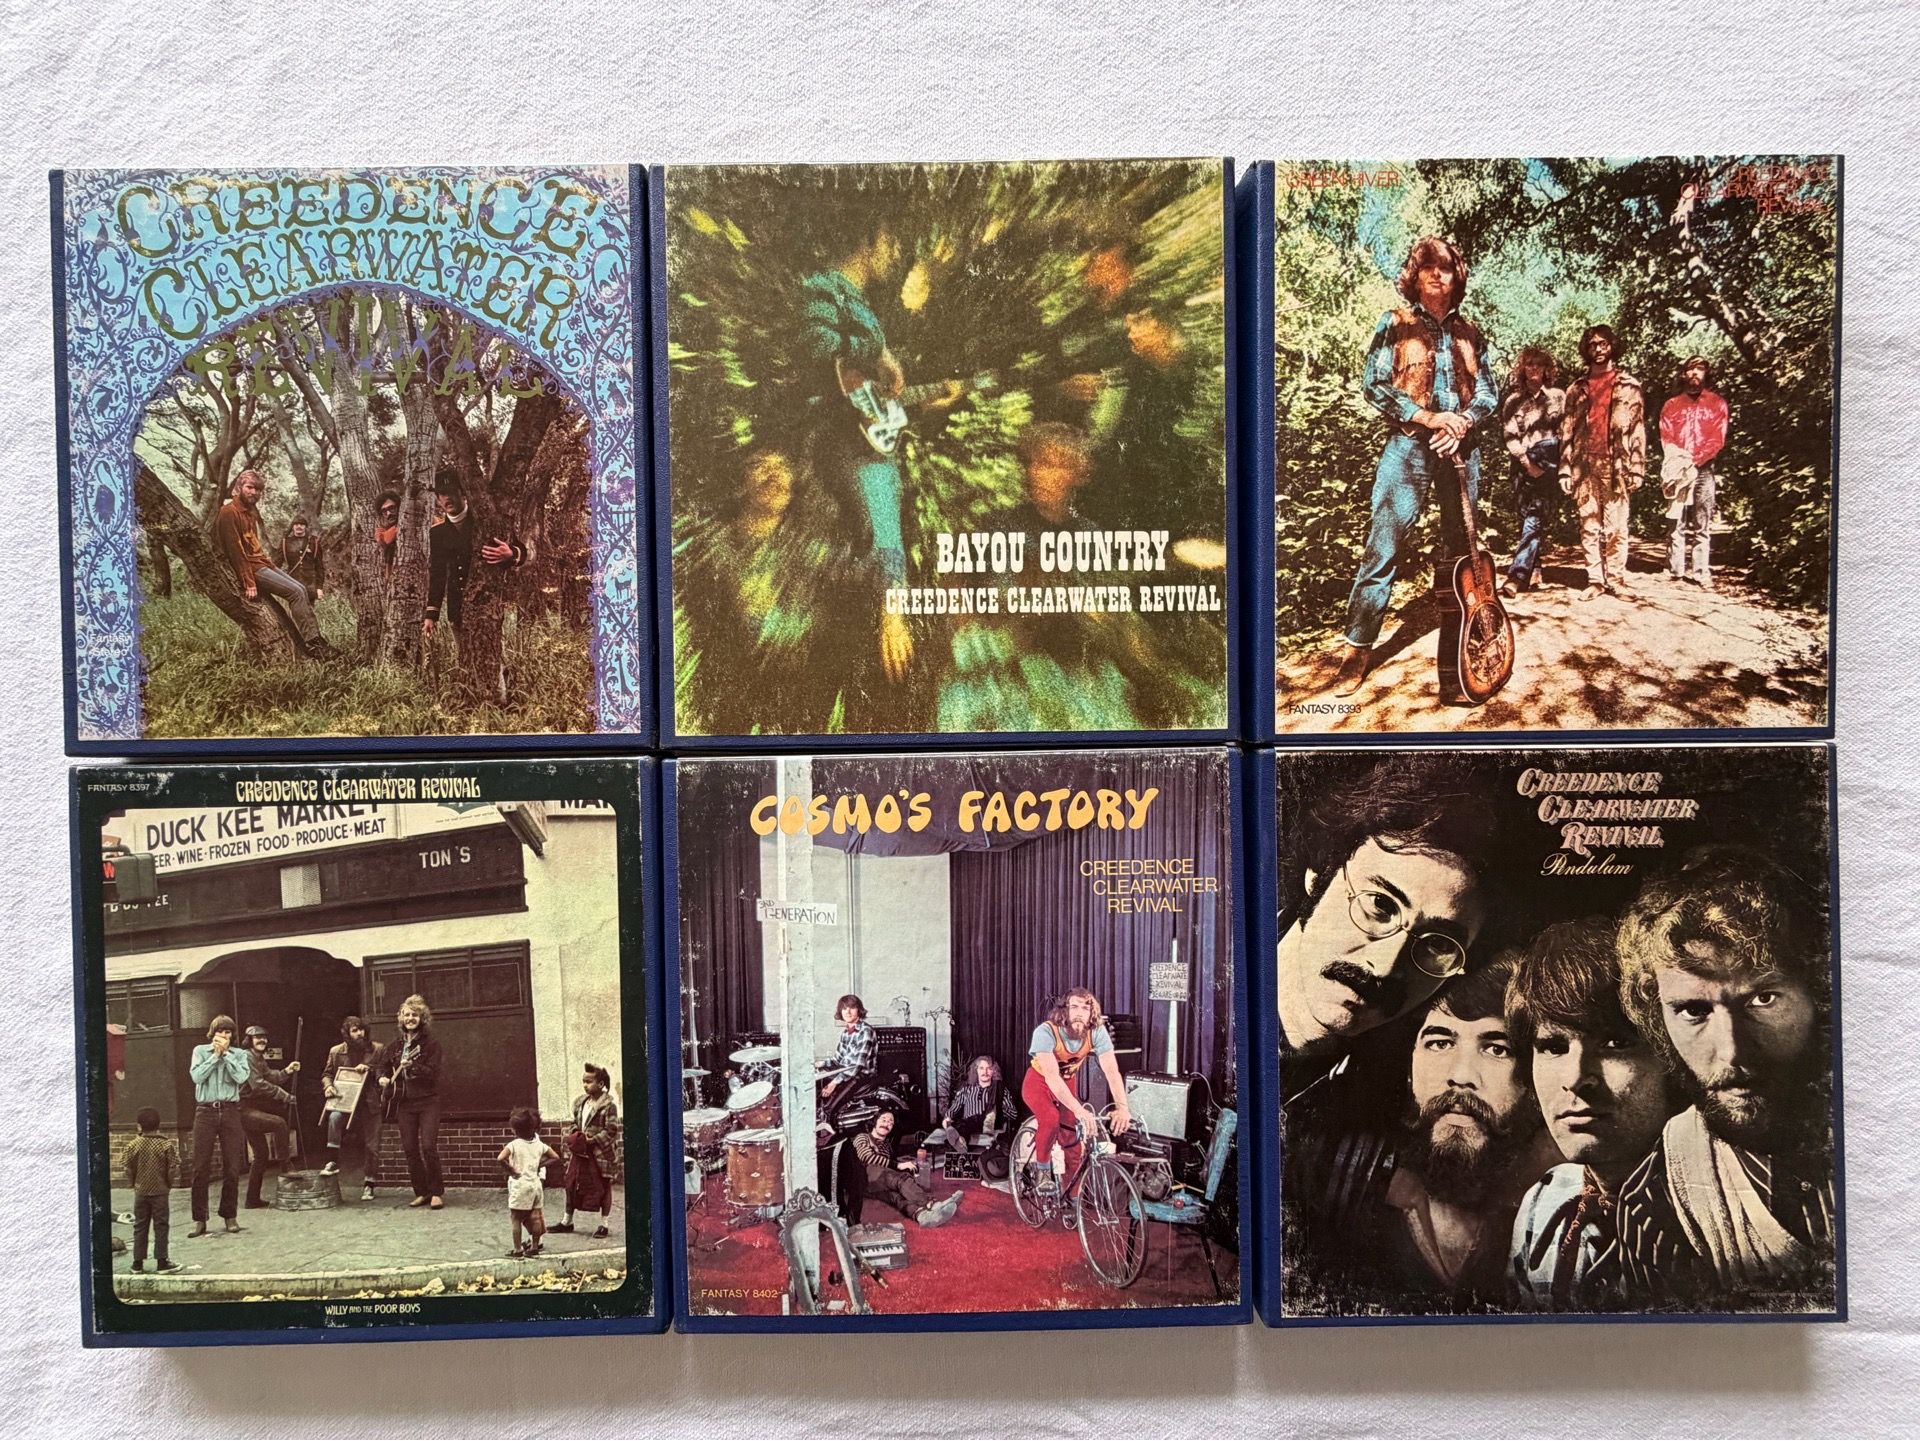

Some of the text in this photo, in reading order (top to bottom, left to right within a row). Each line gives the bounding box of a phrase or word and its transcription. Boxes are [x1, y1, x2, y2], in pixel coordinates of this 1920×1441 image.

[117, 176, 598, 258] CREEDENCE
[142, 229, 579, 350] CLEARWATER
[187, 295, 543, 398] REVIVAL
[936, 530, 1170, 574] BAYOU COUNTRY
[885, 585, 1221, 615] CREEDENCE CLEARWATER REVIVAL
[1289, 704, 1361, 714] FANTASY 8393
[87, 783, 150, 792] FANTASY 8397
[235, 777, 481, 802] CREEDENCE CLEARWATER REVIVAL
[1516, 767, 1663, 799] CREEDENCE
[750, 787, 1160, 836] COSMO'S FACTORY
[1537, 795, 1700, 825] CLEARWATER
[146, 814, 207, 851] DUCK
[217, 806, 265, 840] KEE
[154, 818, 387, 868] EER WINE FROZEN FOOD PRODUCE MEAT
[1560, 821, 1665, 858] REVIVAL
[1079, 858, 1195, 876] CREEDENCE
[1540, 852, 1635, 876] Pendulum
[1093, 877, 1218, 895] CLEARWATER
[1107, 897, 1183, 914] REVIVAL
[701, 1288, 778, 1298] FANTASY 8402
[324, 1304, 349, 1316] WILLY
[349, 1305, 362, 1313] AND
[374, 1303, 398, 1314] POOR
[399, 1303, 421, 1314] BOYS
